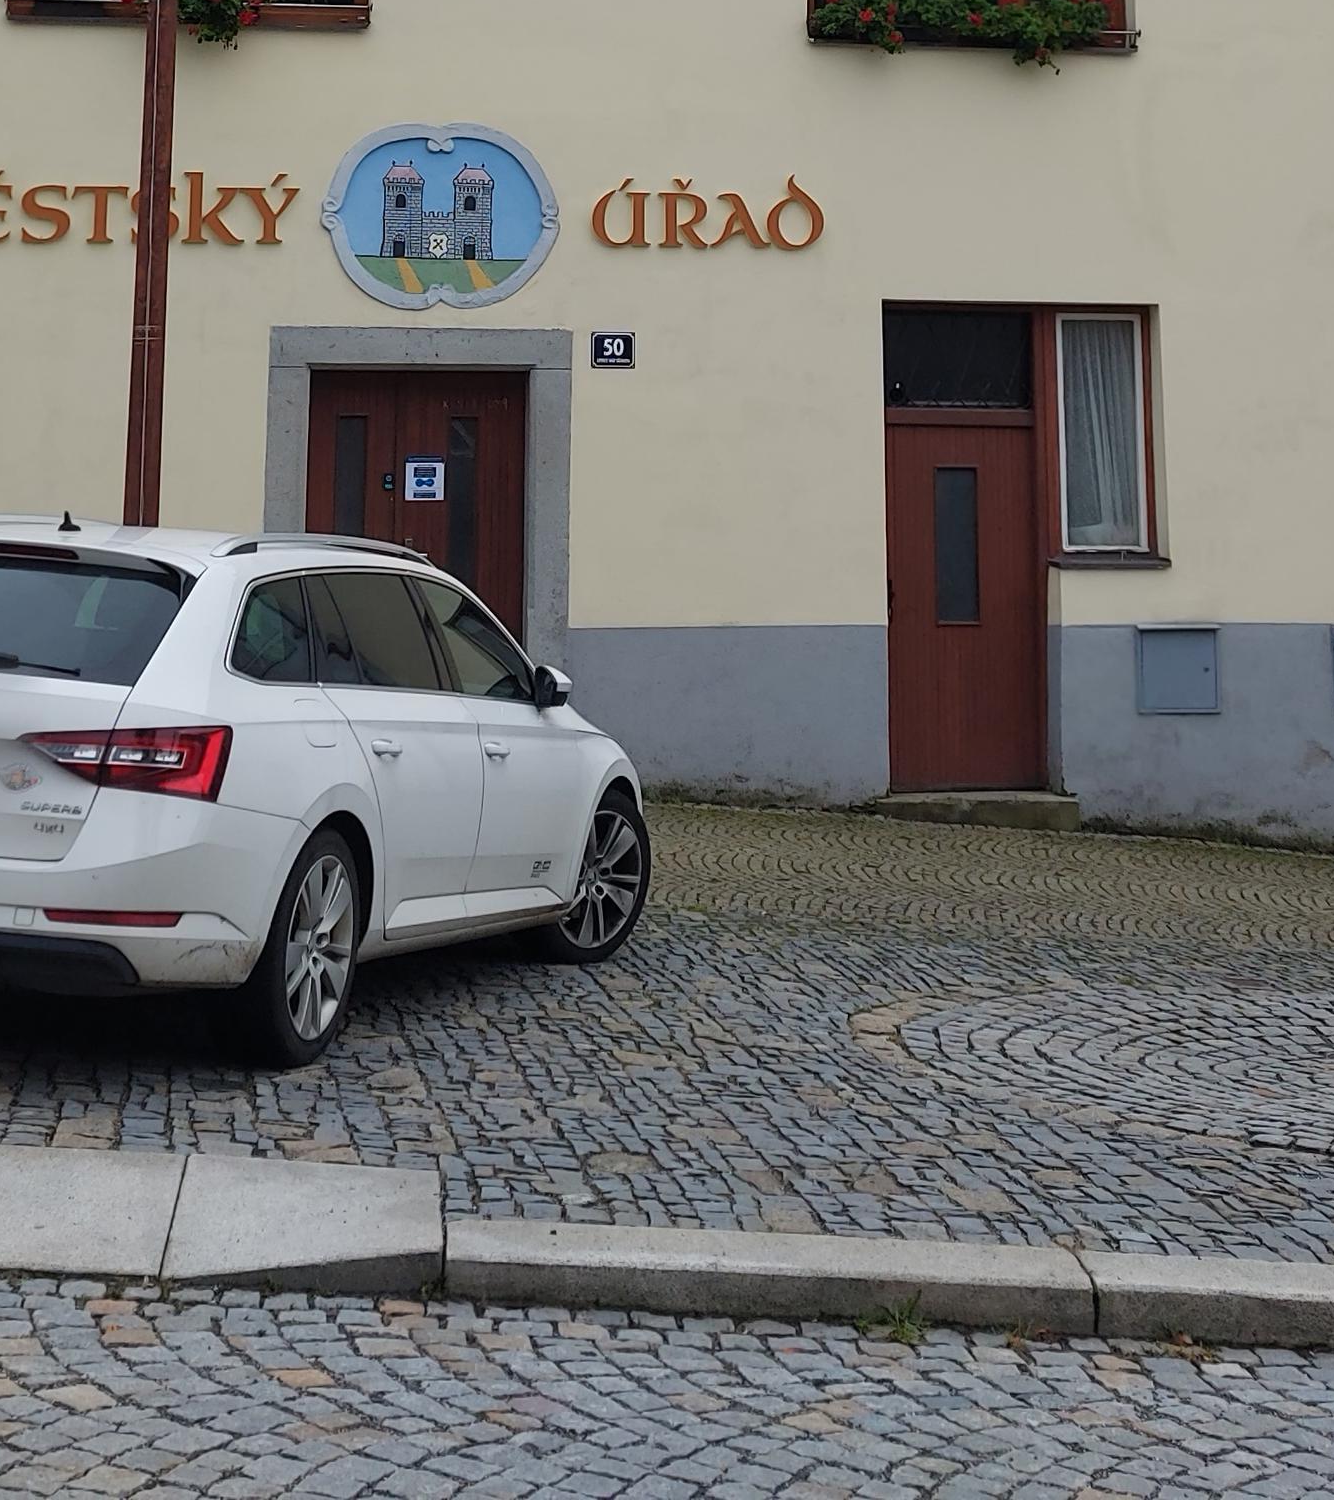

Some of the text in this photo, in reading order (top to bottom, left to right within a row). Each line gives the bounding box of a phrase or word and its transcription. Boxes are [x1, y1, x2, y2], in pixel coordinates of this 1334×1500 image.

[592, 174, 825, 249] ÚŘAD
[603, 338, 624, 356] 50
[20, 800, 83, 815] SUPERB
